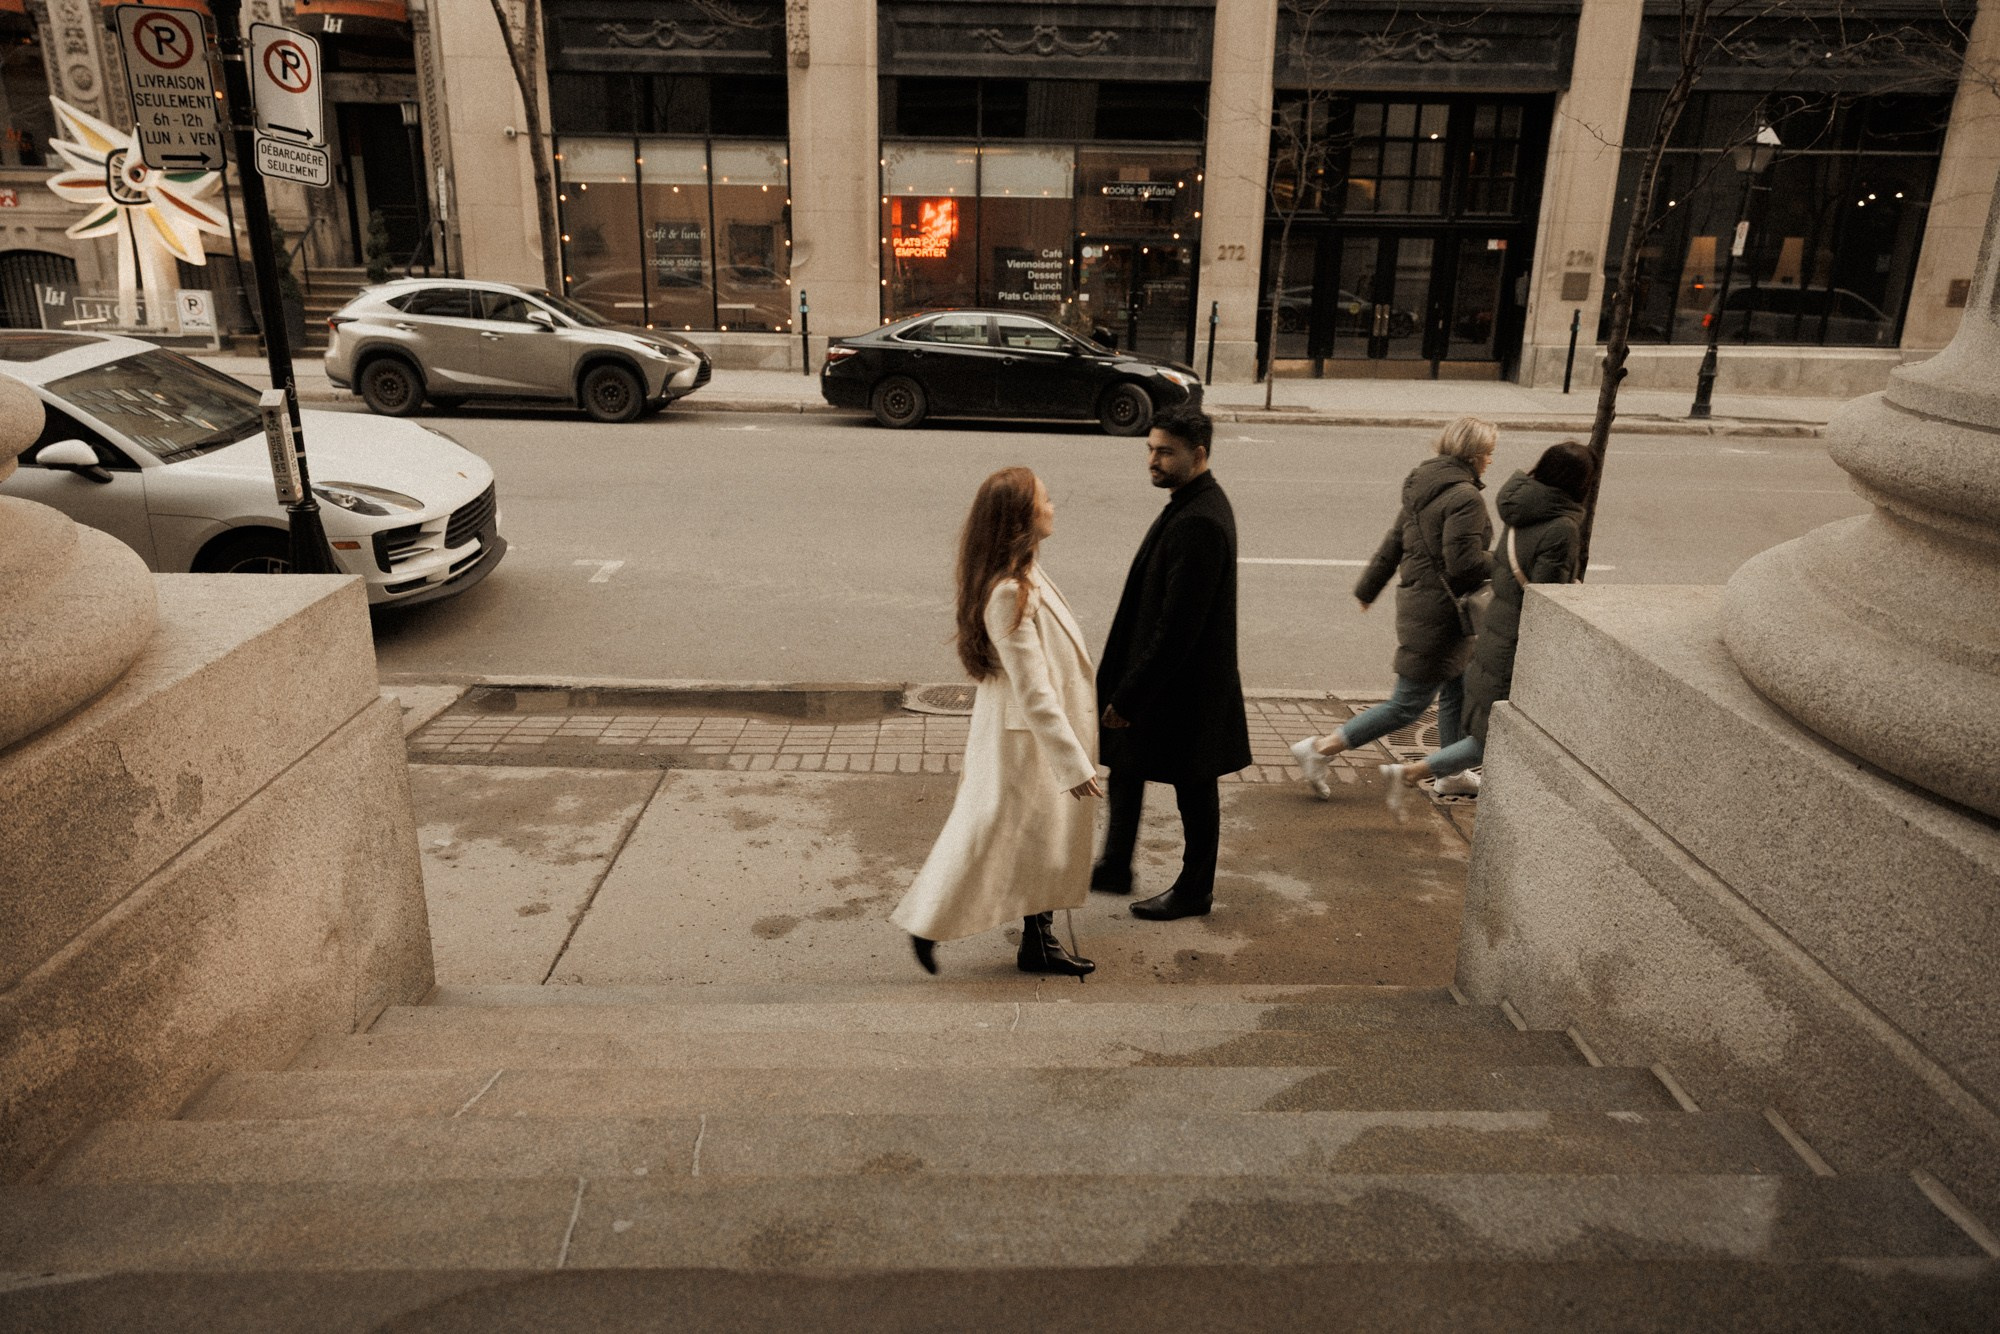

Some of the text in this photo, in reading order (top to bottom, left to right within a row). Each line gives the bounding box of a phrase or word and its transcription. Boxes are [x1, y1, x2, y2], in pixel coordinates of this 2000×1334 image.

[154, 26, 176, 55] P
[281, 49, 300, 80] P
[136, 74, 205, 91] LIVRAISON
[136, 93, 212, 109] SEULEMENT
[153, 113, 169, 126] 6h
[182, 113, 203, 127] 12h
[145, 131, 171, 145] LUN
[191, 132, 216, 146] VEN
[261, 143, 324, 167] DÉBARCADÈRE
[267, 159, 318, 179] SEULEMENT
[1137, 185, 1176, 196] stéfanie
[893, 237, 950, 248] PLATS POUR
[895, 247, 947, 258] EMPORTER
[1041, 249, 1063, 258] Café
[1217, 244, 1246, 261] 272
[1006, 259, 1063, 269] Viennoiserie
[1027, 270, 1062, 280] Dessert
[1033, 281, 1062, 290] Lunch
[998, 291, 1062, 301] Plats Cuisinés
[81, 303, 176, 322] LHOTL
